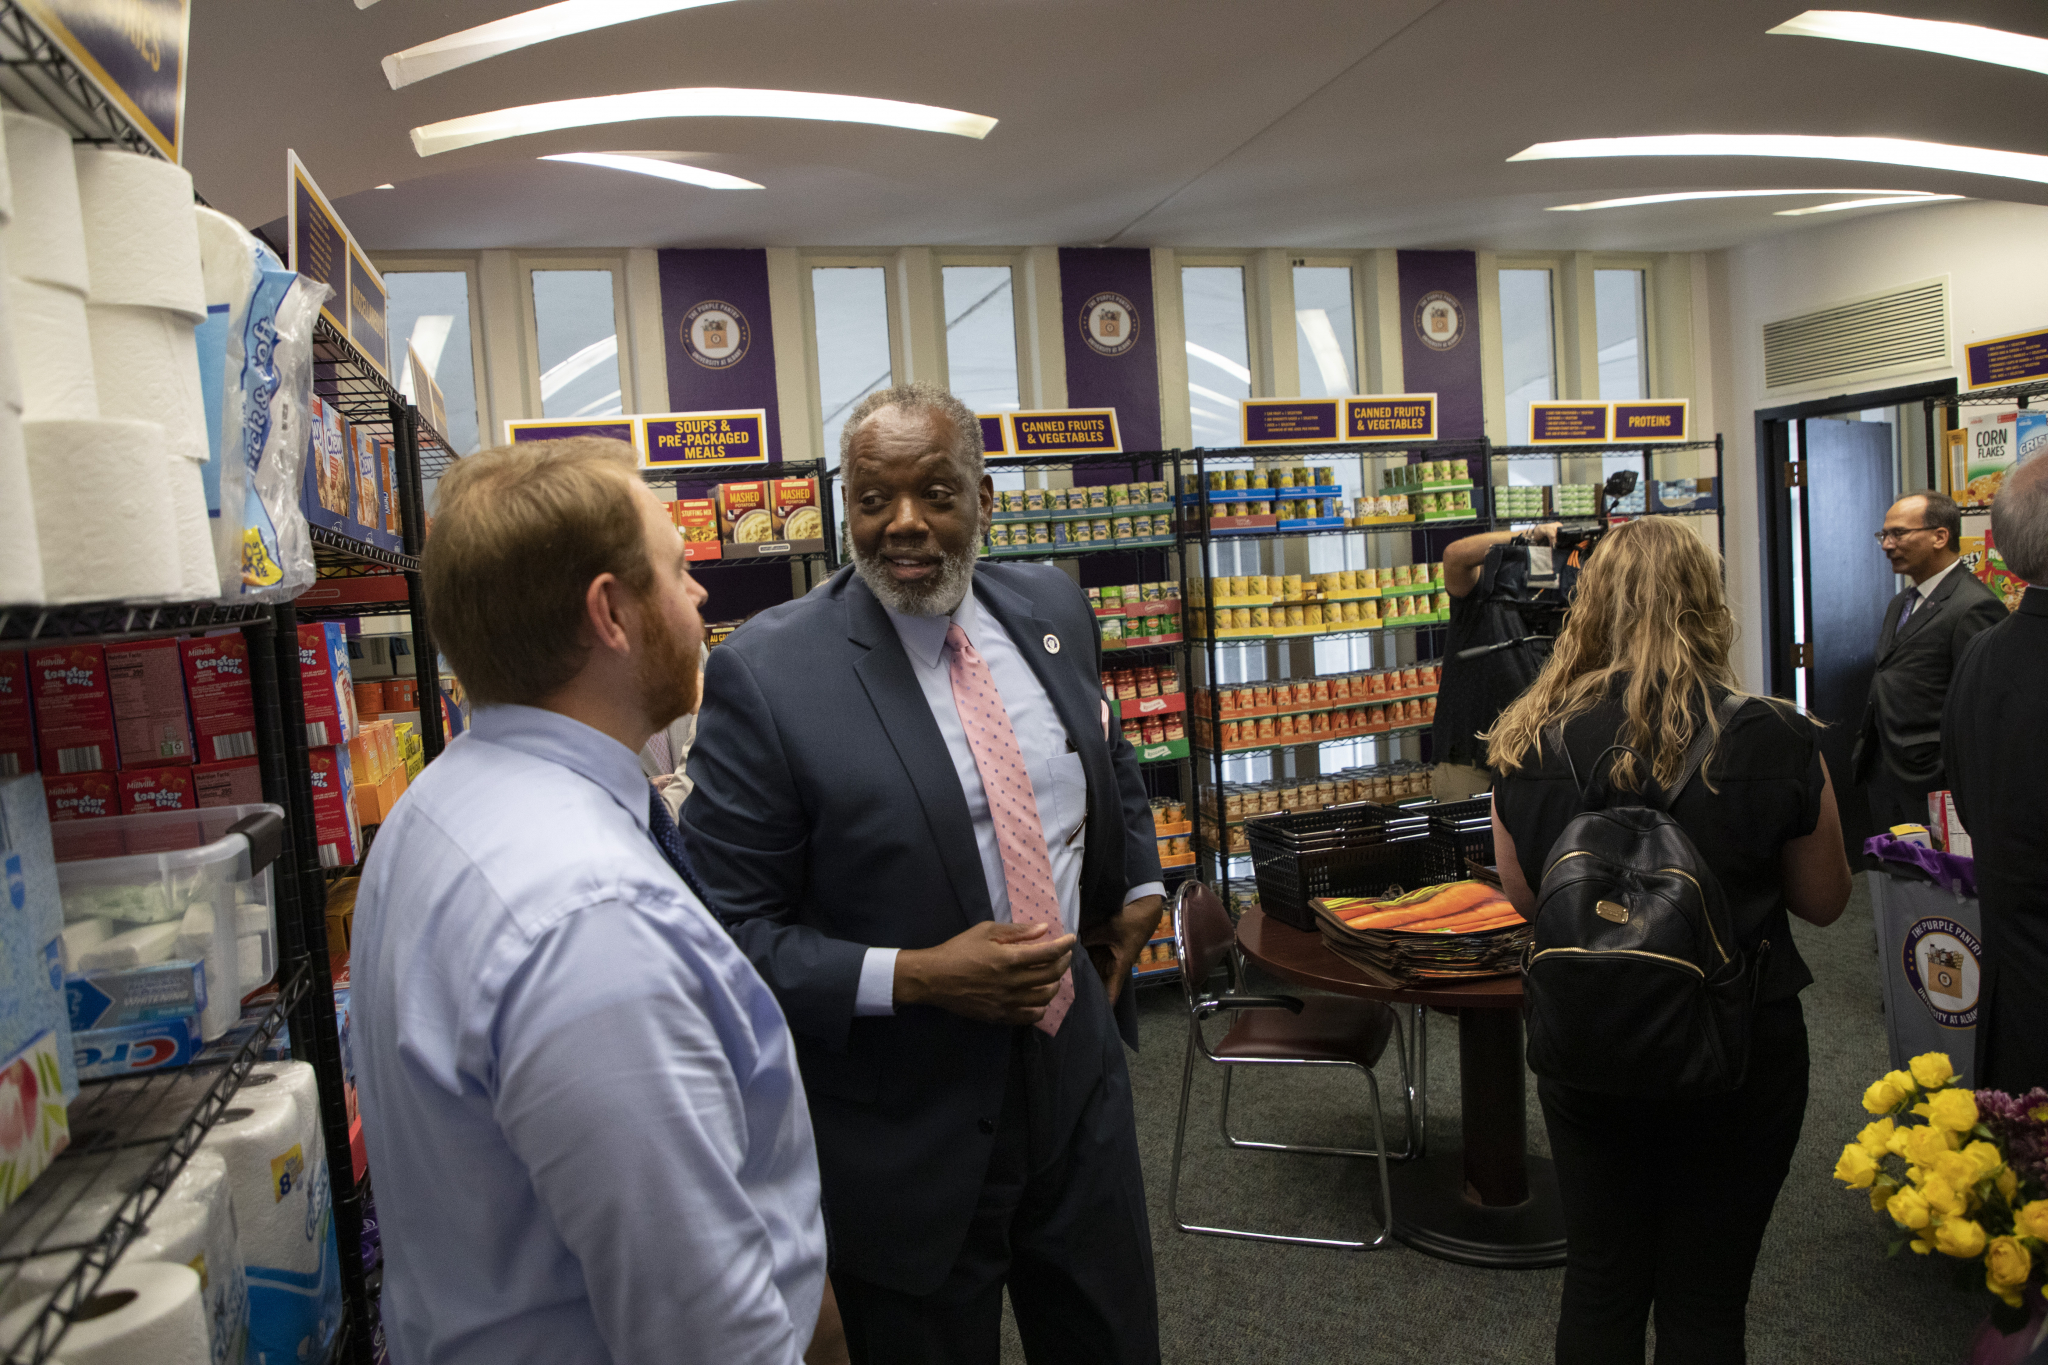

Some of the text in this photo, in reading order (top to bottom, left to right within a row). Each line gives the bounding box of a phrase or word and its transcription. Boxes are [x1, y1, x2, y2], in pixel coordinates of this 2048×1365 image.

[688, 303, 740, 320] THE PURPLE PANTRY
[692, 351, 720, 366] UNIVERSITY
[727, 348, 743, 363] ALBANY
[1354, 405, 1426, 419] CANNED FRUITS
[675, 420, 731, 434] SOUPS &
[1021, 420, 1105, 433] CANNED FRUITS
[1357, 418, 1423, 431] & VEGETABLES
[1628, 415, 1672, 428] PROTEINS
[327, 428, 343, 455] Chewy
[658, 431, 749, 448] PRE-PACKAGED
[1027, 431, 1104, 444] & VEGETABLES
[1976, 428, 2007, 447] CORN
[2019, 434, 2048, 455] CRIS
[684, 445, 726, 459] MEALS
[1977, 446, 2005, 459] FLAKES
[360, 452, 374, 478] Chewy
[730, 491, 760, 504] MASHED
[780, 489, 810, 500] MASHED
[681, 508, 713, 517] STUFFING MIX
[1960, 550, 1982, 565] sty
[188, 646, 216, 658] Millville
[195, 655, 243, 670] toaster
[299, 657, 317, 665] rts
[43, 666, 94, 681] toaster
[217, 665, 244, 675] tarts
[66, 677, 94, 687] tarts
[126, 779, 156, 790] Millville
[311, 778, 328, 788] rts
[56, 795, 106, 809] toaster
[134, 788, 182, 802] toaster
[78, 804, 106, 815] tarts
[156, 798, 182, 809] tarts
[1911, 920, 1982, 956] THE PURPLE PANTRY
[1949, 1015, 1958, 1024] AT
[1960, 1008, 1978, 1024] ALBAN
[75, 1036, 177, 1069] Cre
[279, 1173, 292, 1196] 8
